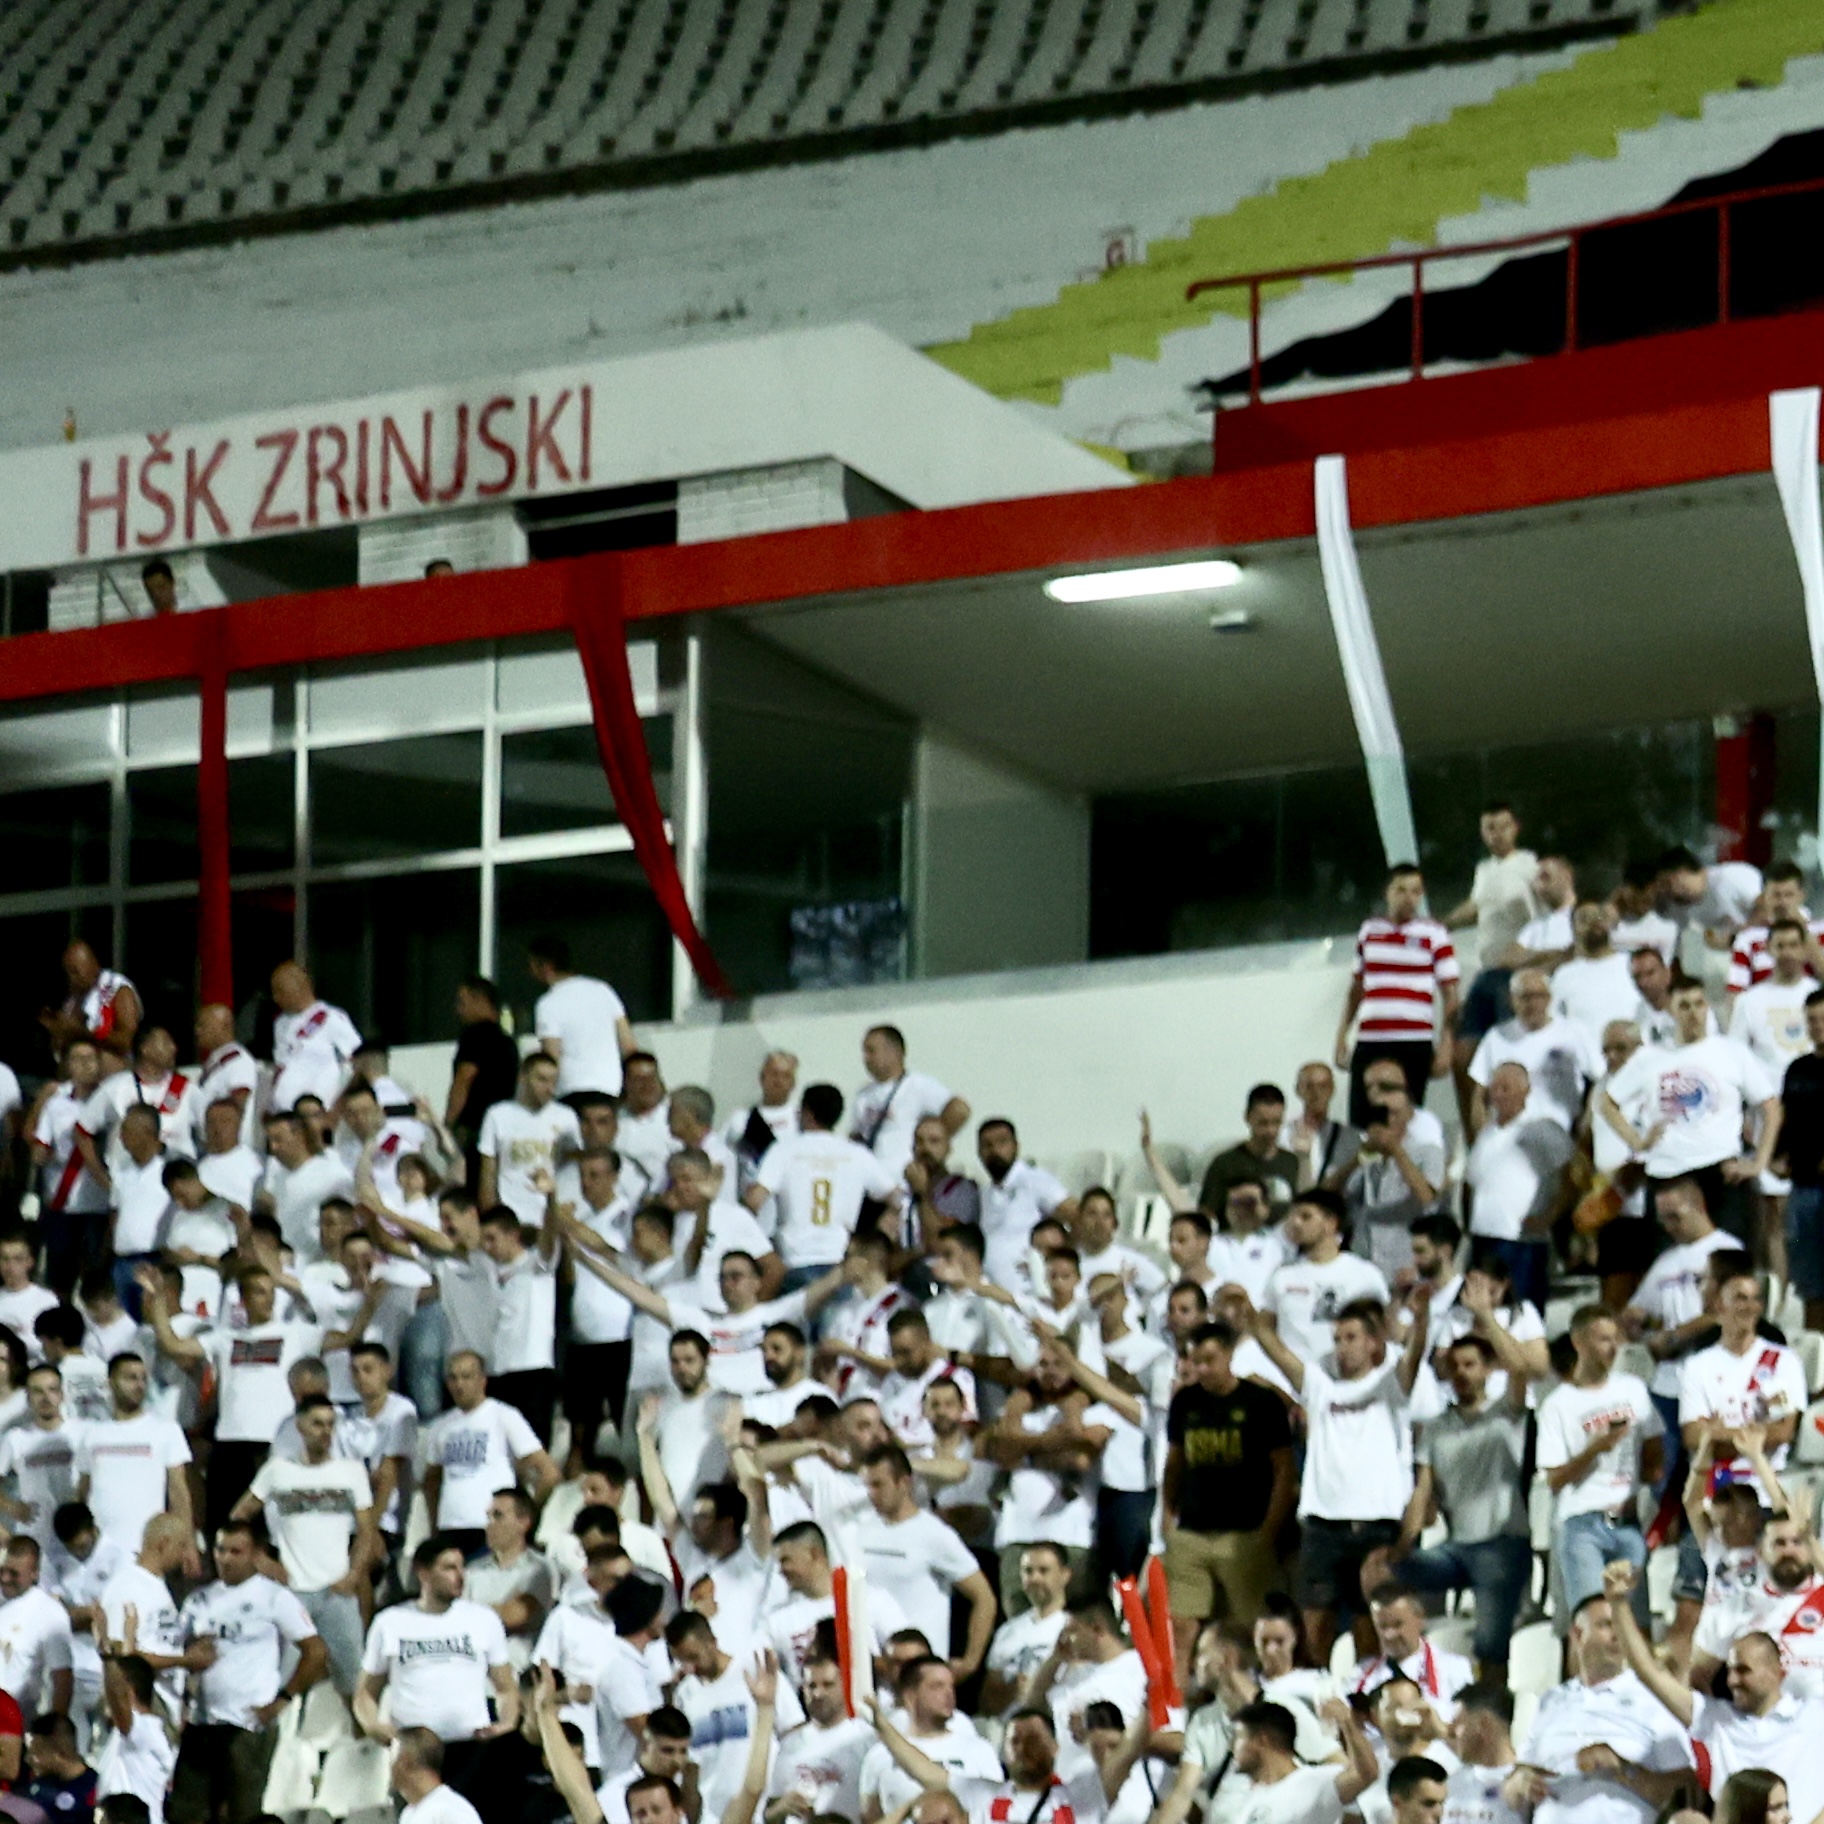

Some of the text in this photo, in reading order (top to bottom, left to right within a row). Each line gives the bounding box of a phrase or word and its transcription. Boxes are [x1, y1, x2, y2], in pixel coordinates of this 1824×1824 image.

[75, 383, 595, 556] HŠK ZRINJSKI
[811, 1177, 832, 1227] 8
